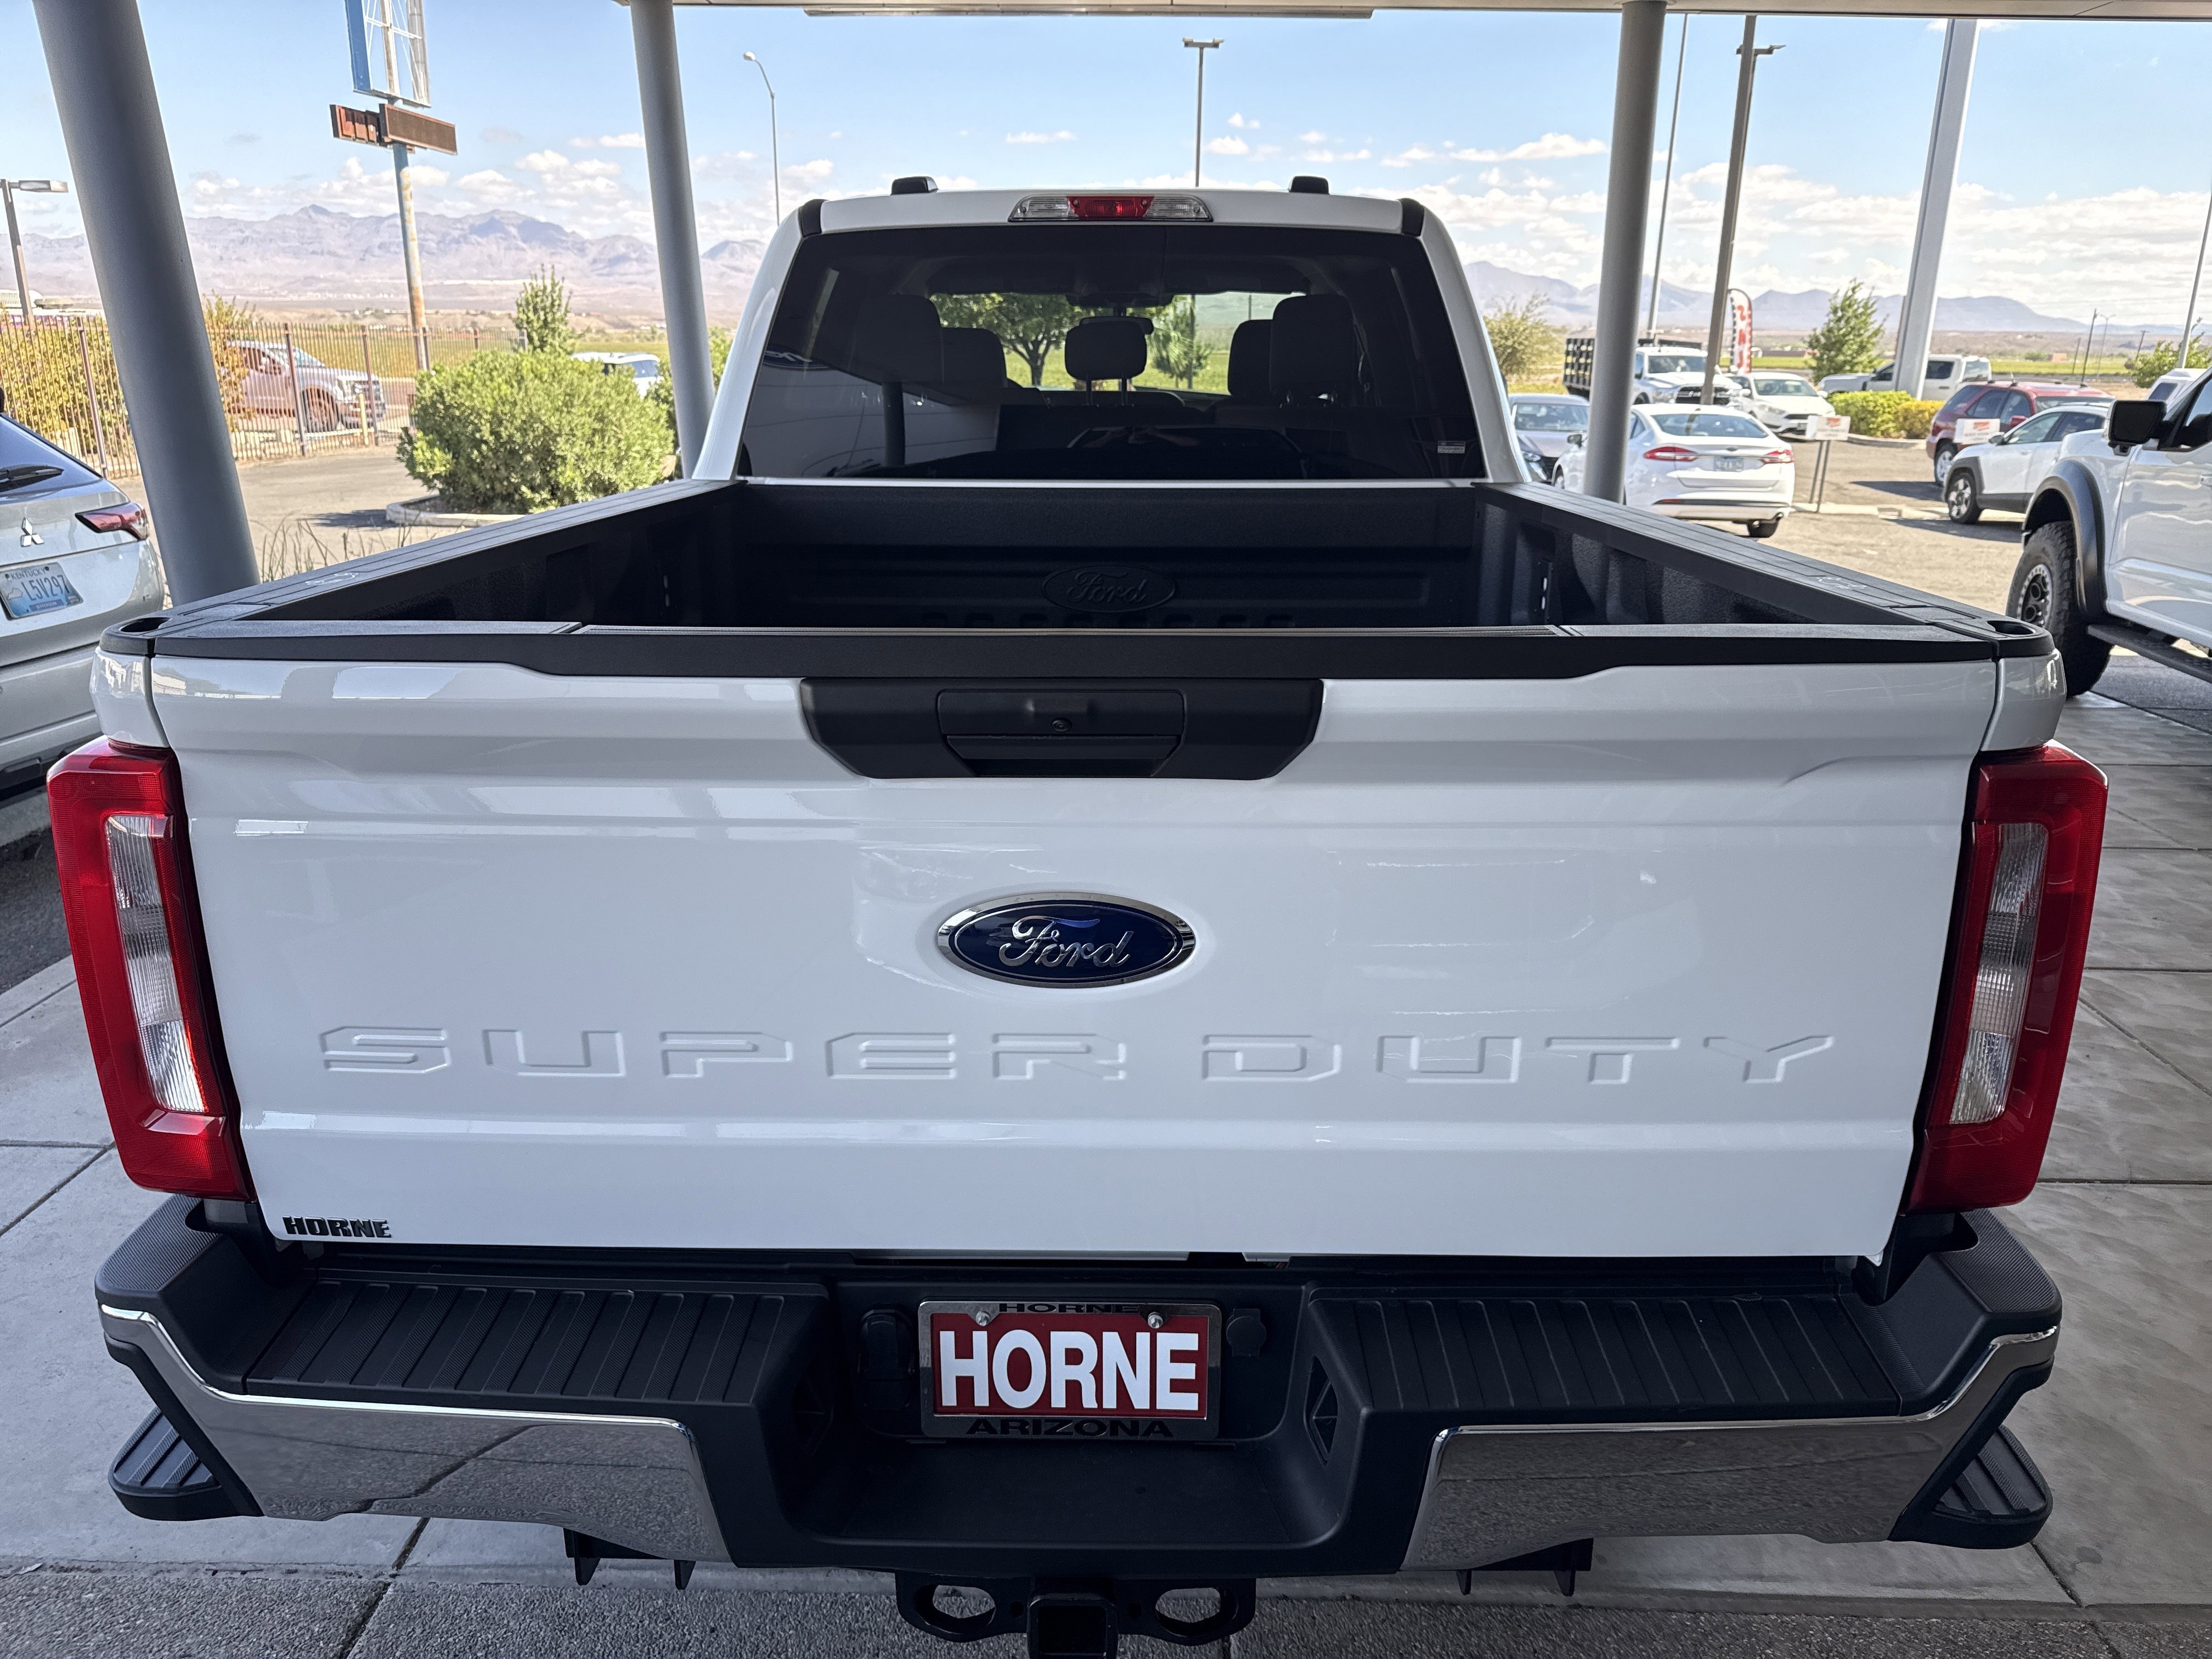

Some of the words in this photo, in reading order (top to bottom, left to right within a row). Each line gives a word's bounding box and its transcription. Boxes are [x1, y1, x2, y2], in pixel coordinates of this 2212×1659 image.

[10, 568, 46, 580] KENTUCKY
[21, 574, 70, 601] L5V297
[1066, 570, 1148, 602] Ford
[998, 915, 1134, 967] Ford
[319, 1026, 1125, 1080] SUPER
[1201, 1034, 1834, 1084] DUTY
[281, 1216, 392, 1238] HORNE
[998, 1302, 1143, 1313] HORNE
[939, 1329, 1199, 1411] HORNE
[966, 1418, 1175, 1438] ARIZONA
